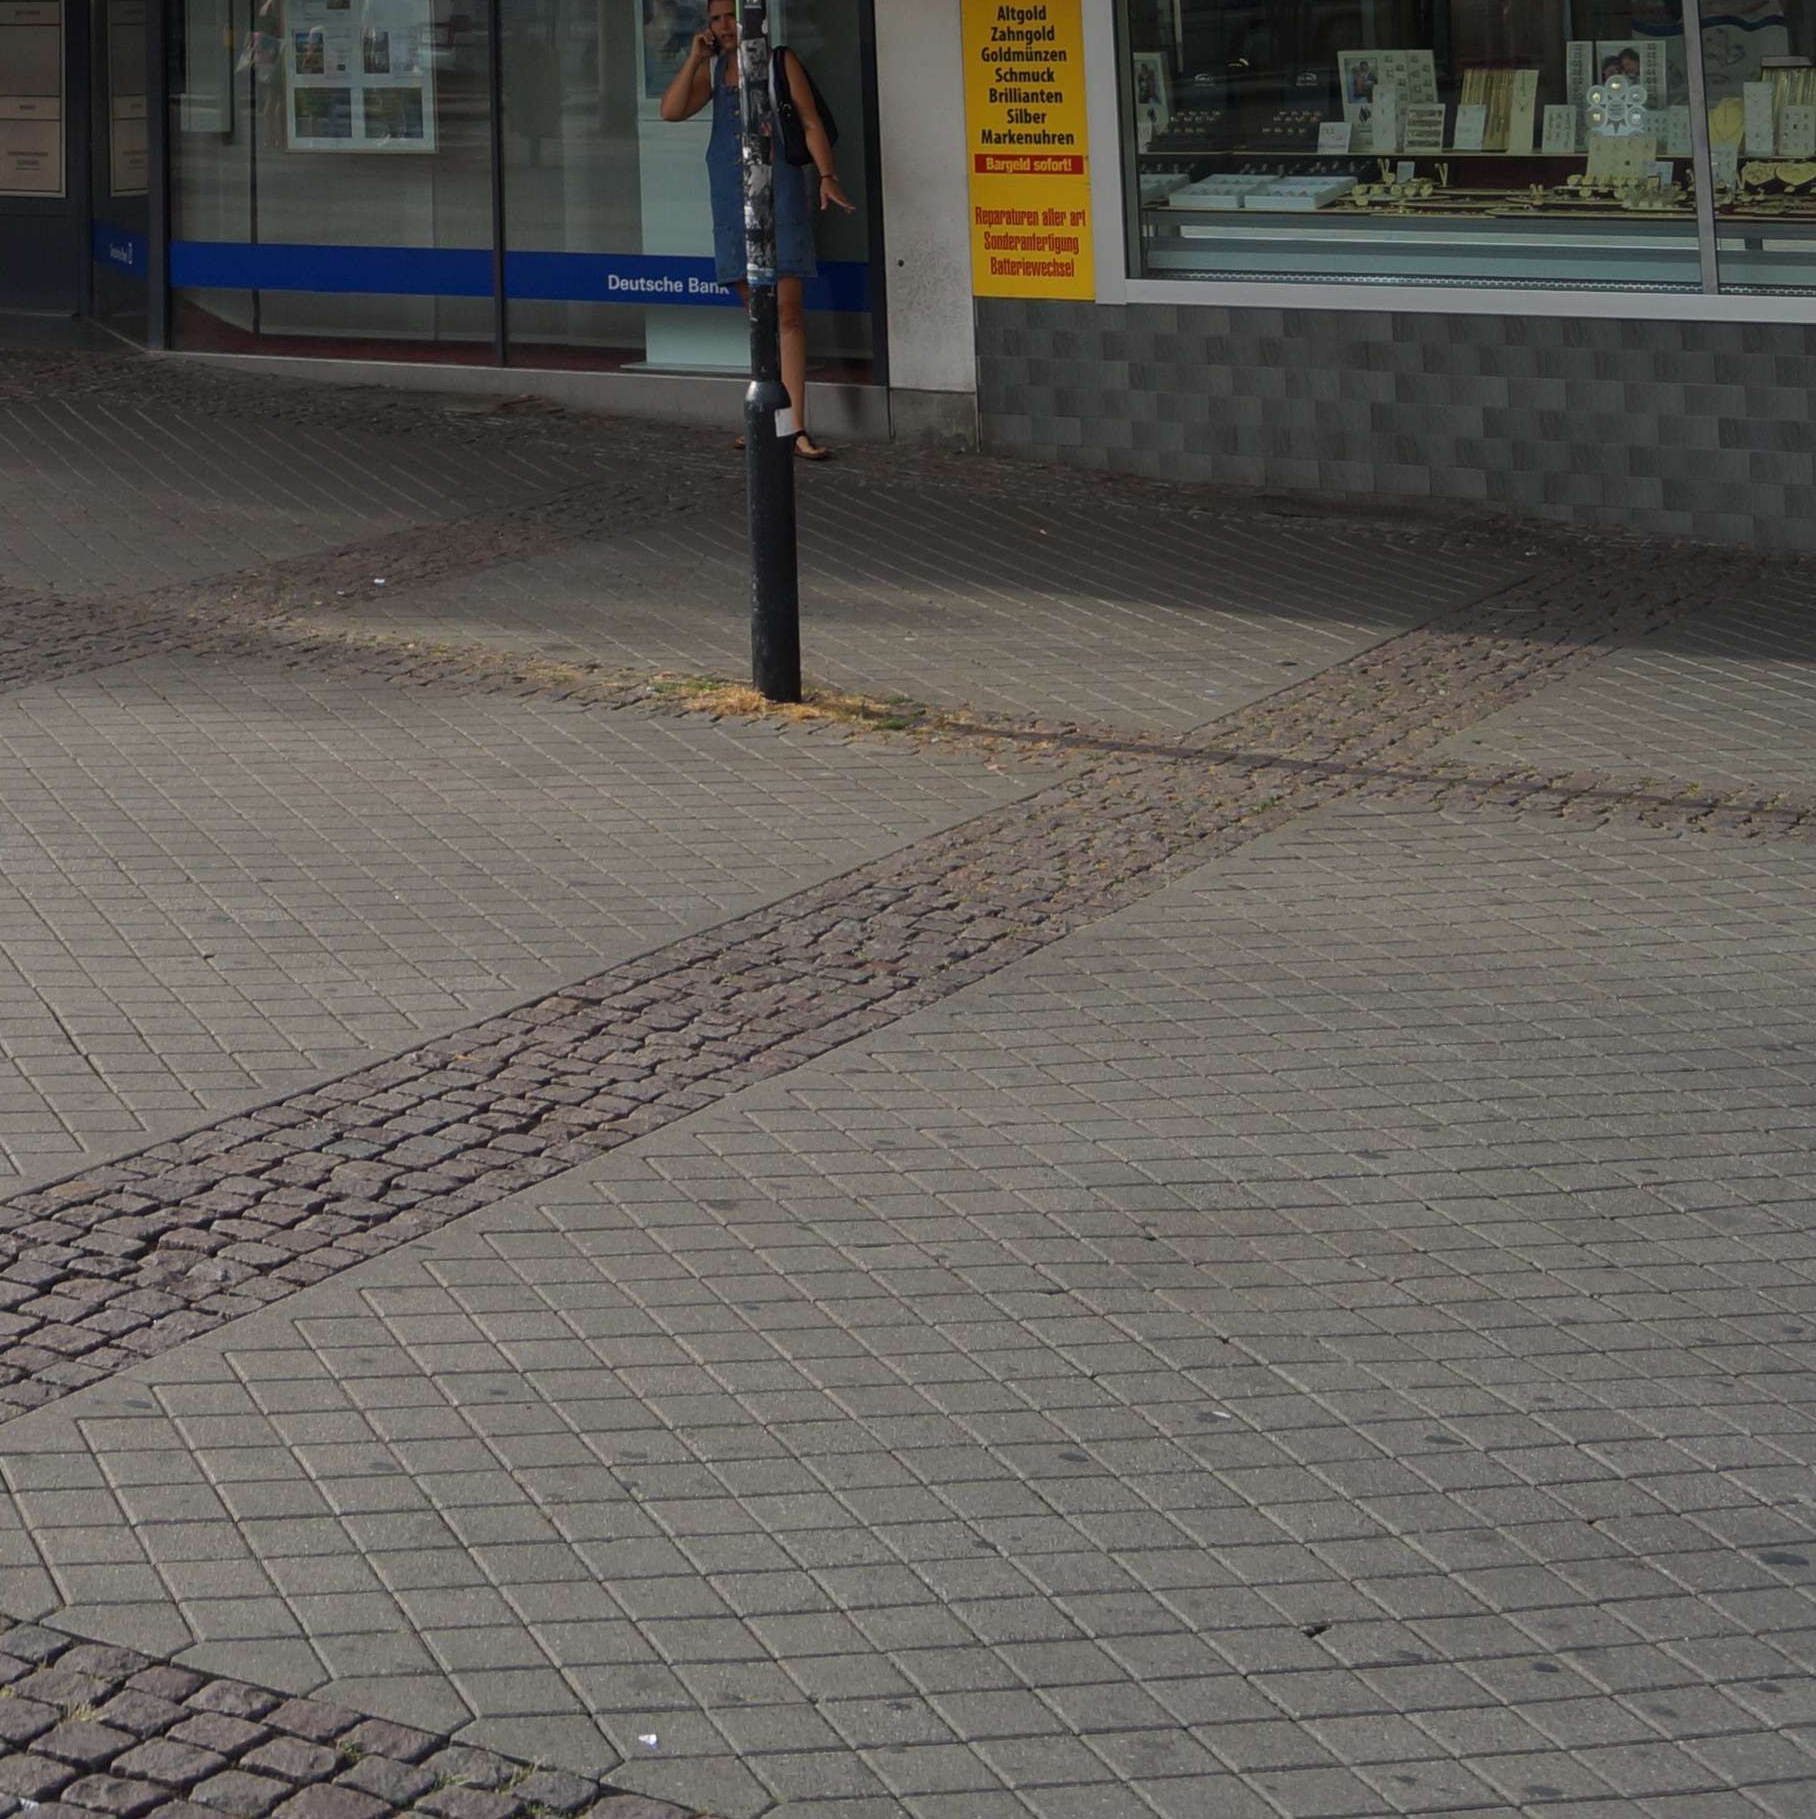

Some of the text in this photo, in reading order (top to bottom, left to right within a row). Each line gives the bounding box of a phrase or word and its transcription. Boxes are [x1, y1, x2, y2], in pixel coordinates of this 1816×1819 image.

[997, 5, 1047, 24] Altgold
[991, 26, 1055, 45] Zahngold
[981, 46, 1067, 62] Goldmünzen
[995, 67, 1055, 83] Schmuck
[989, 87, 1063, 103] Brillianten
[1007, 108, 1047, 124] Silber
[981, 129, 1074, 145] Markenuhren
[986, 157, 1072, 173] Bargeld sofort!
[975, 206, 1086, 228] Reparaturen aller art
[984, 231, 1079, 254] Sonderanfertigung
[990, 257, 1075, 277] Batteriewechsel
[607, 274, 684, 293] Deutsche
